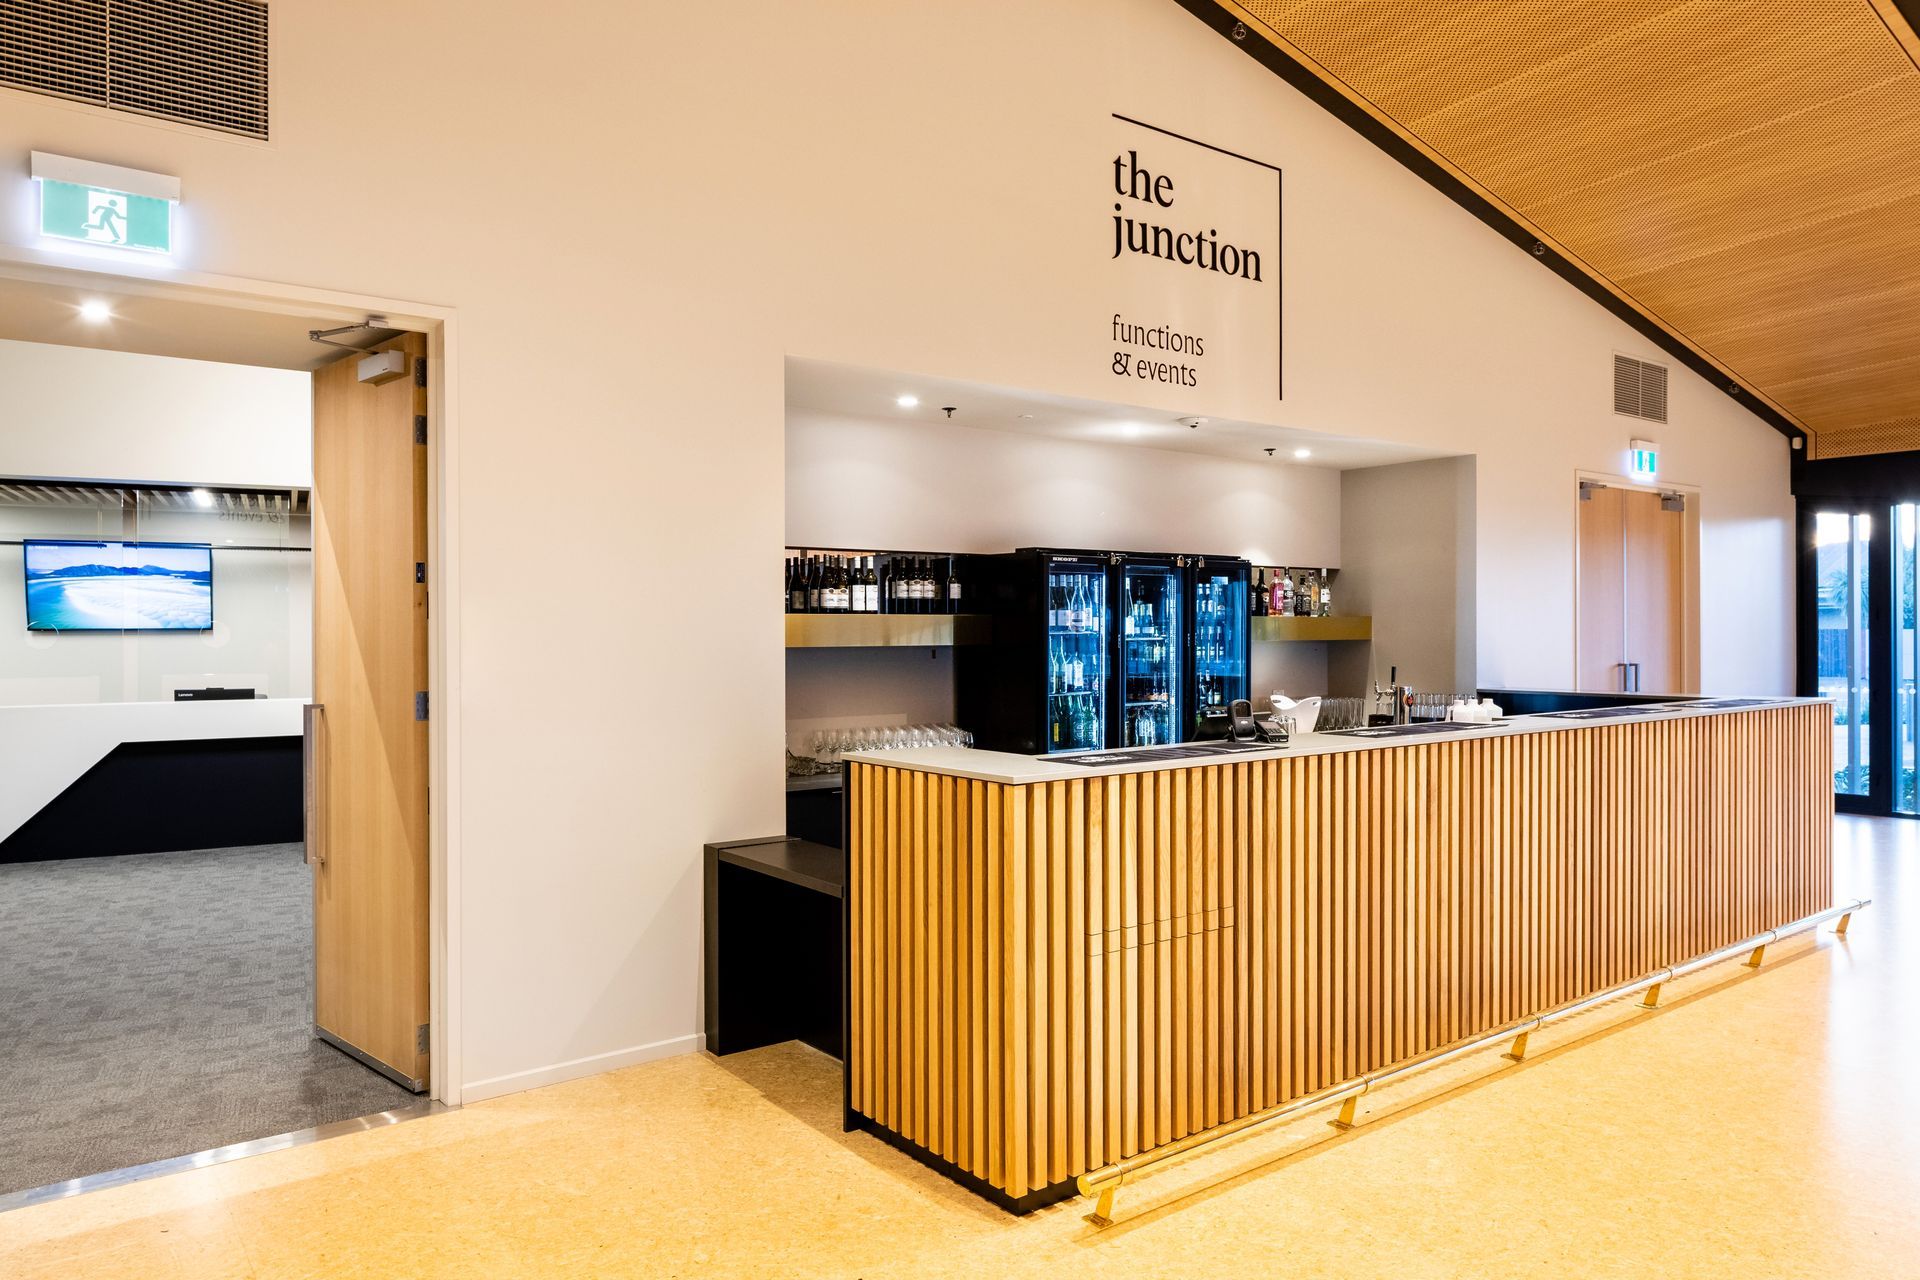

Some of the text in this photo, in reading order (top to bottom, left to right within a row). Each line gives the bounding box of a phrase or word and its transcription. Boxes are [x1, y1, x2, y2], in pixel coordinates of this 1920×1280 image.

[1112, 150, 1174, 208] the
[1111, 203, 1263, 283] junction
[1112, 313, 1204, 357] functions
[1112, 352, 1197, 387] & events
